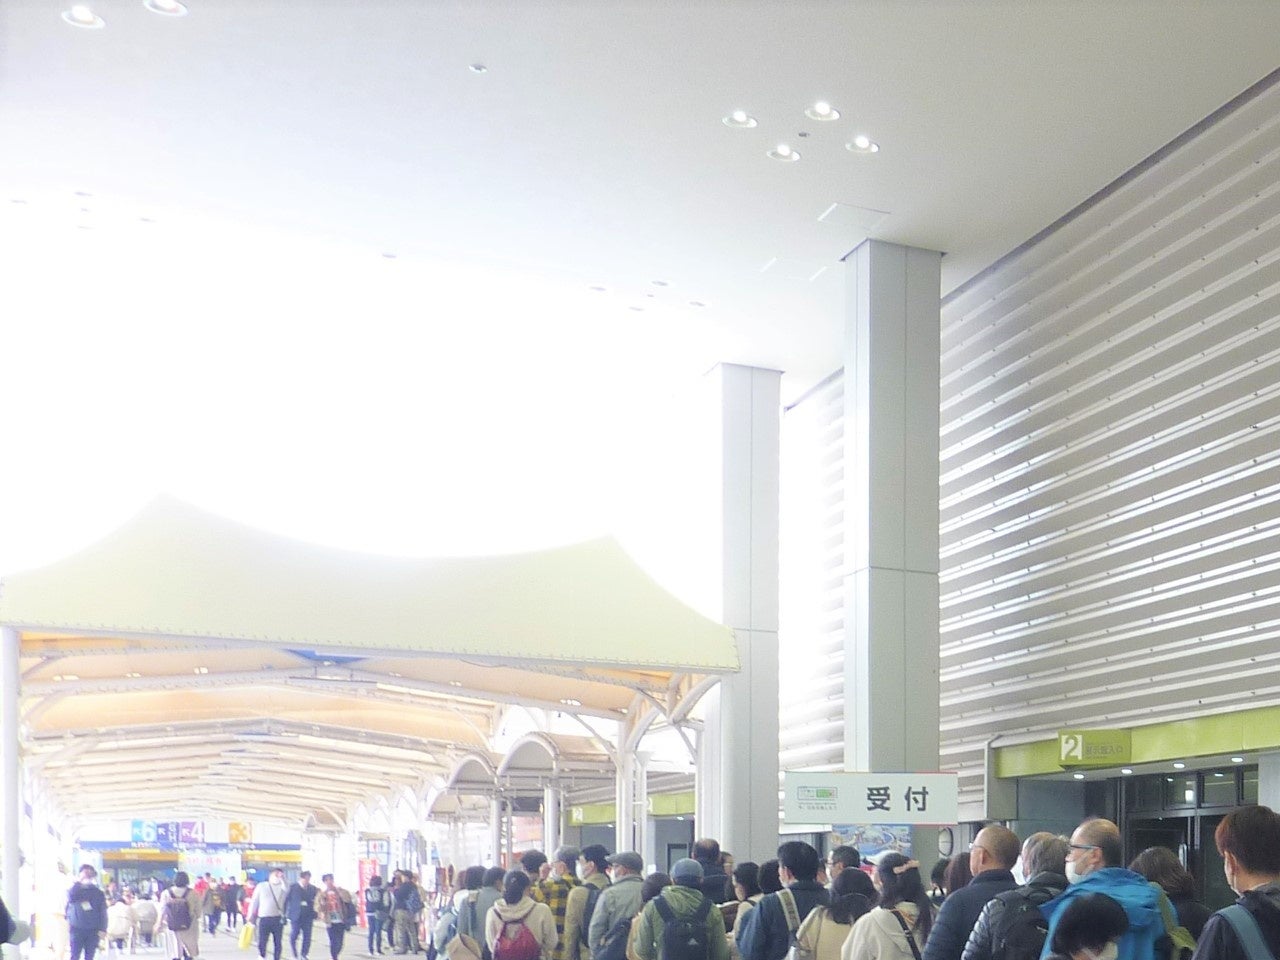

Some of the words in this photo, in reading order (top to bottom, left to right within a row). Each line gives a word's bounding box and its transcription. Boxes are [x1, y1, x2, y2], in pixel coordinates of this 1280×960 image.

[1063, 735, 1081, 761] 2
[866, 786, 929, 812] 受付
[191, 821, 203, 842] 4
